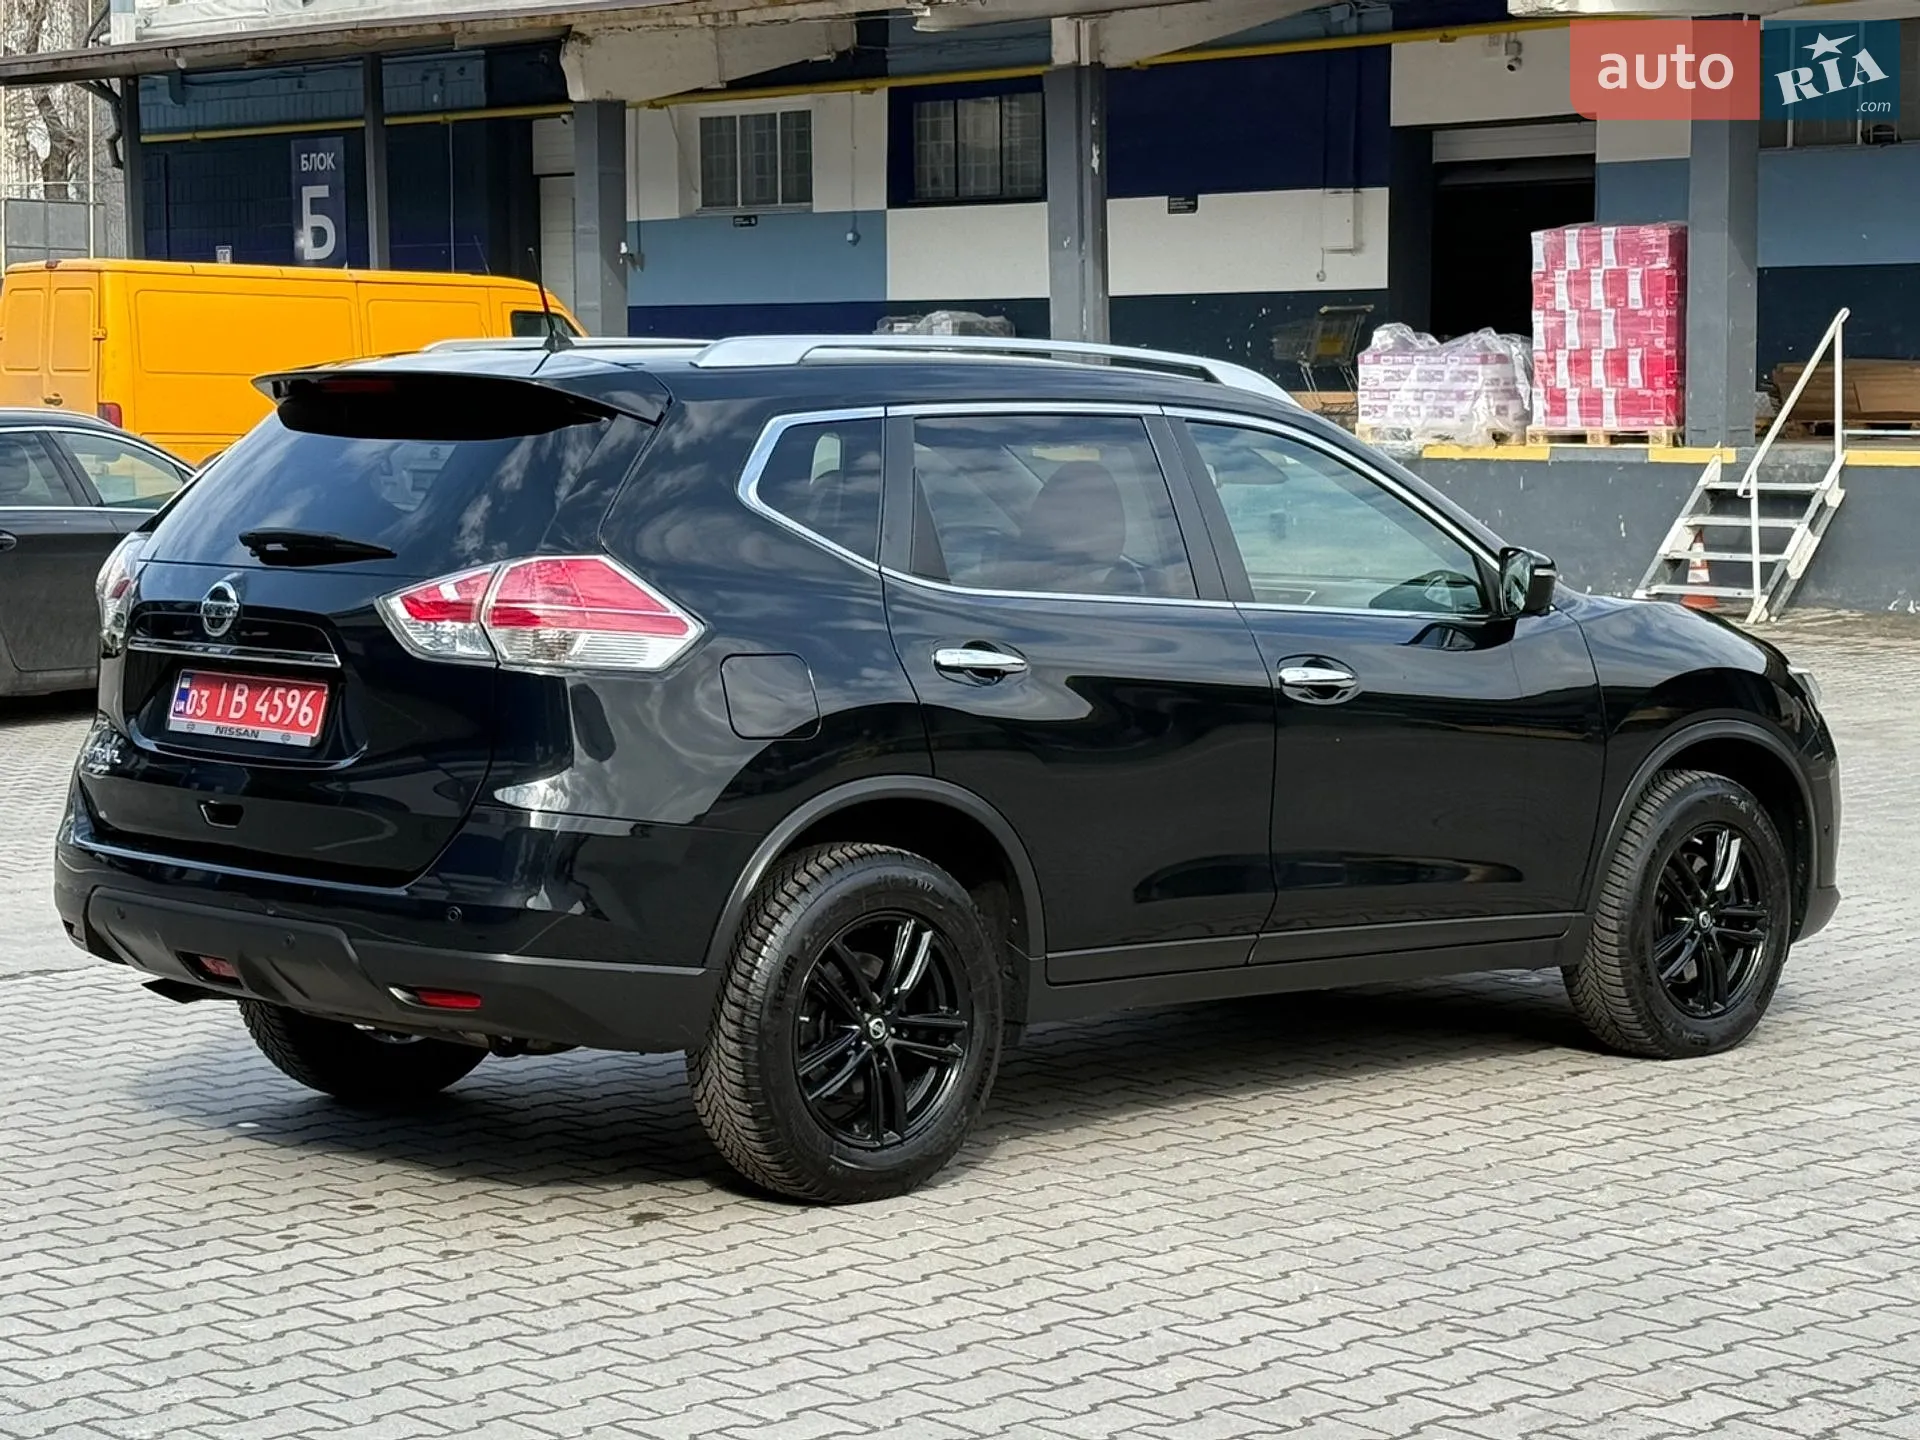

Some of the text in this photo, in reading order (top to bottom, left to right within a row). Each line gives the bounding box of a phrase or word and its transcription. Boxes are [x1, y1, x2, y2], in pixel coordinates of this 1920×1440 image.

[301, 152, 336, 172] БЛОК
[302, 184, 336, 260] Б
[186, 689, 210, 717] 03
[254, 686, 316, 727] 4596
[215, 726, 260, 739] NISSAN
